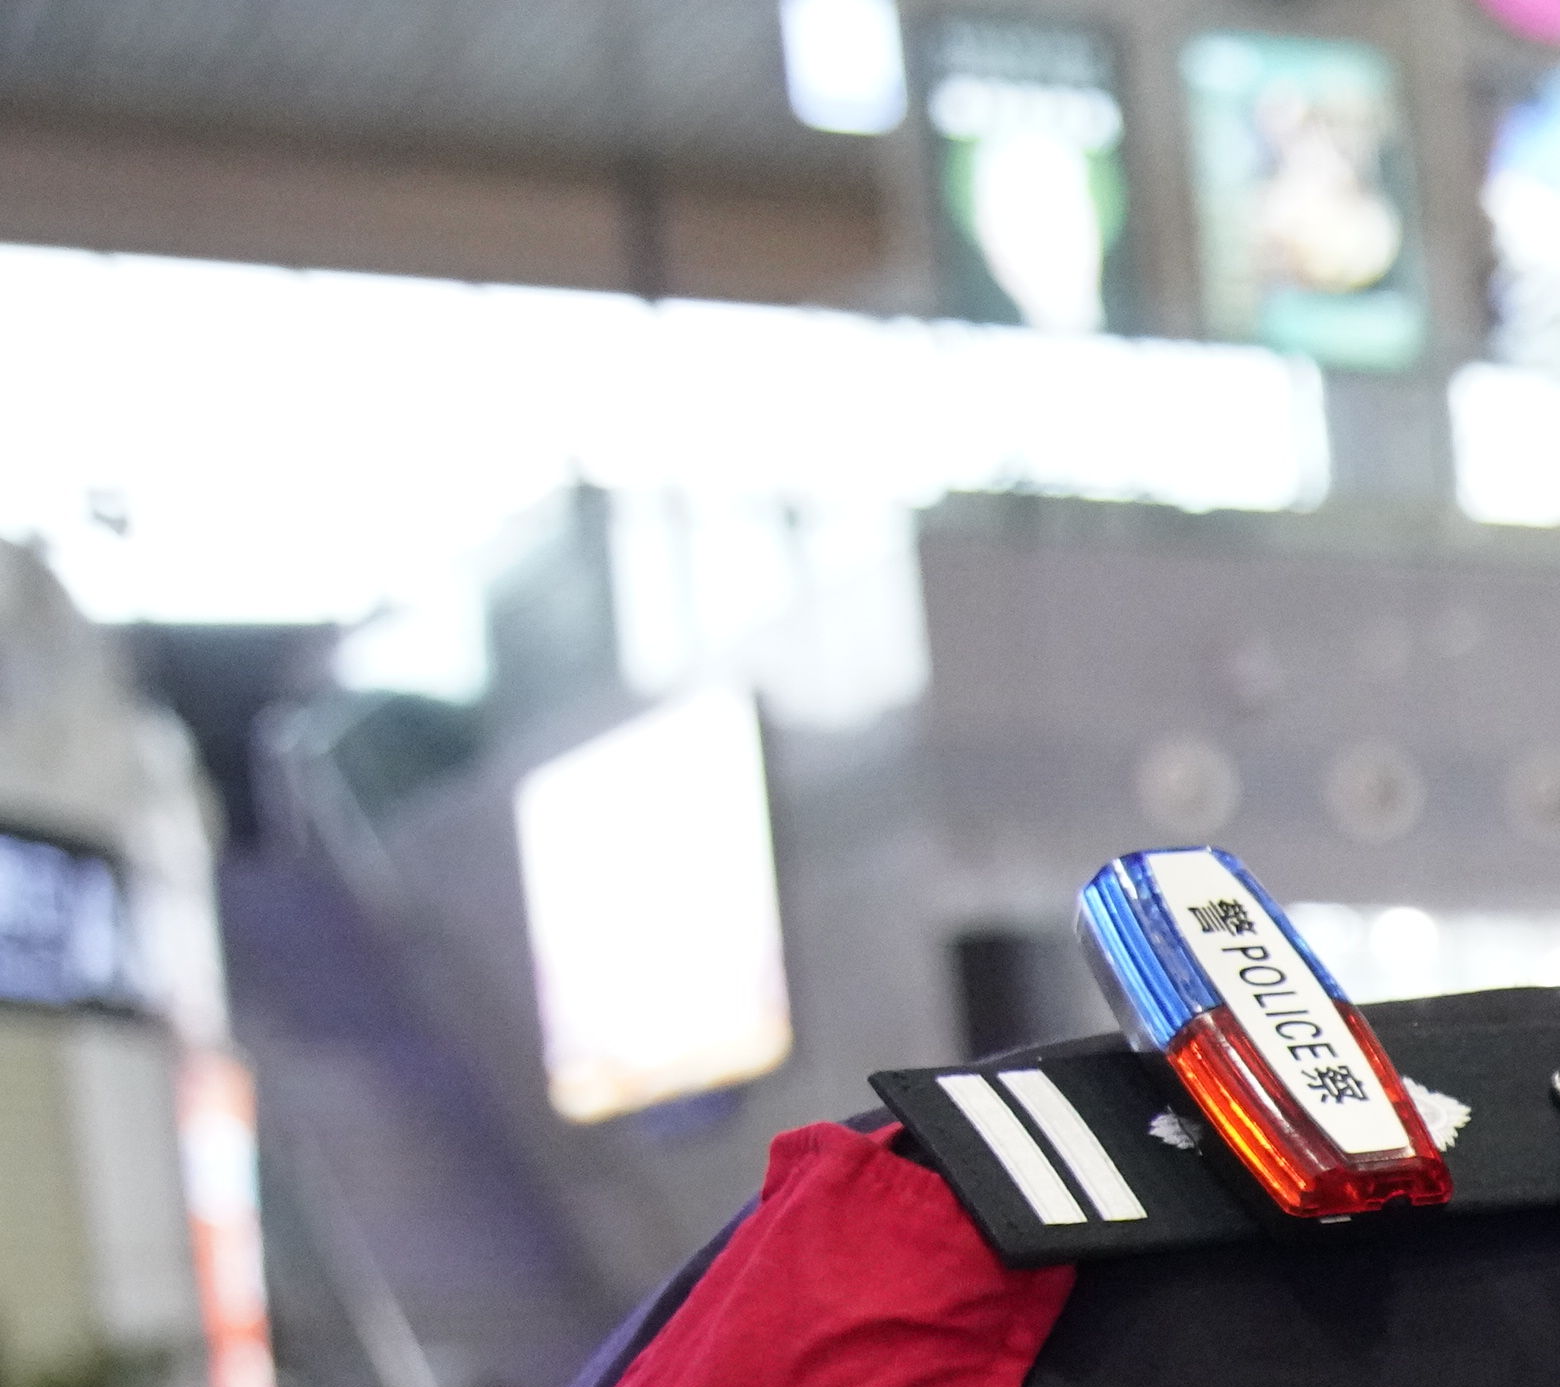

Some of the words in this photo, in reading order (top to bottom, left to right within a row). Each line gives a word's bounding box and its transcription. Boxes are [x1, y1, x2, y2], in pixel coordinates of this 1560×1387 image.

[1187, 899, 1258, 937] 警
[1221, 945, 1340, 1061] POLICE
[1301, 1065, 1369, 1104] 察
